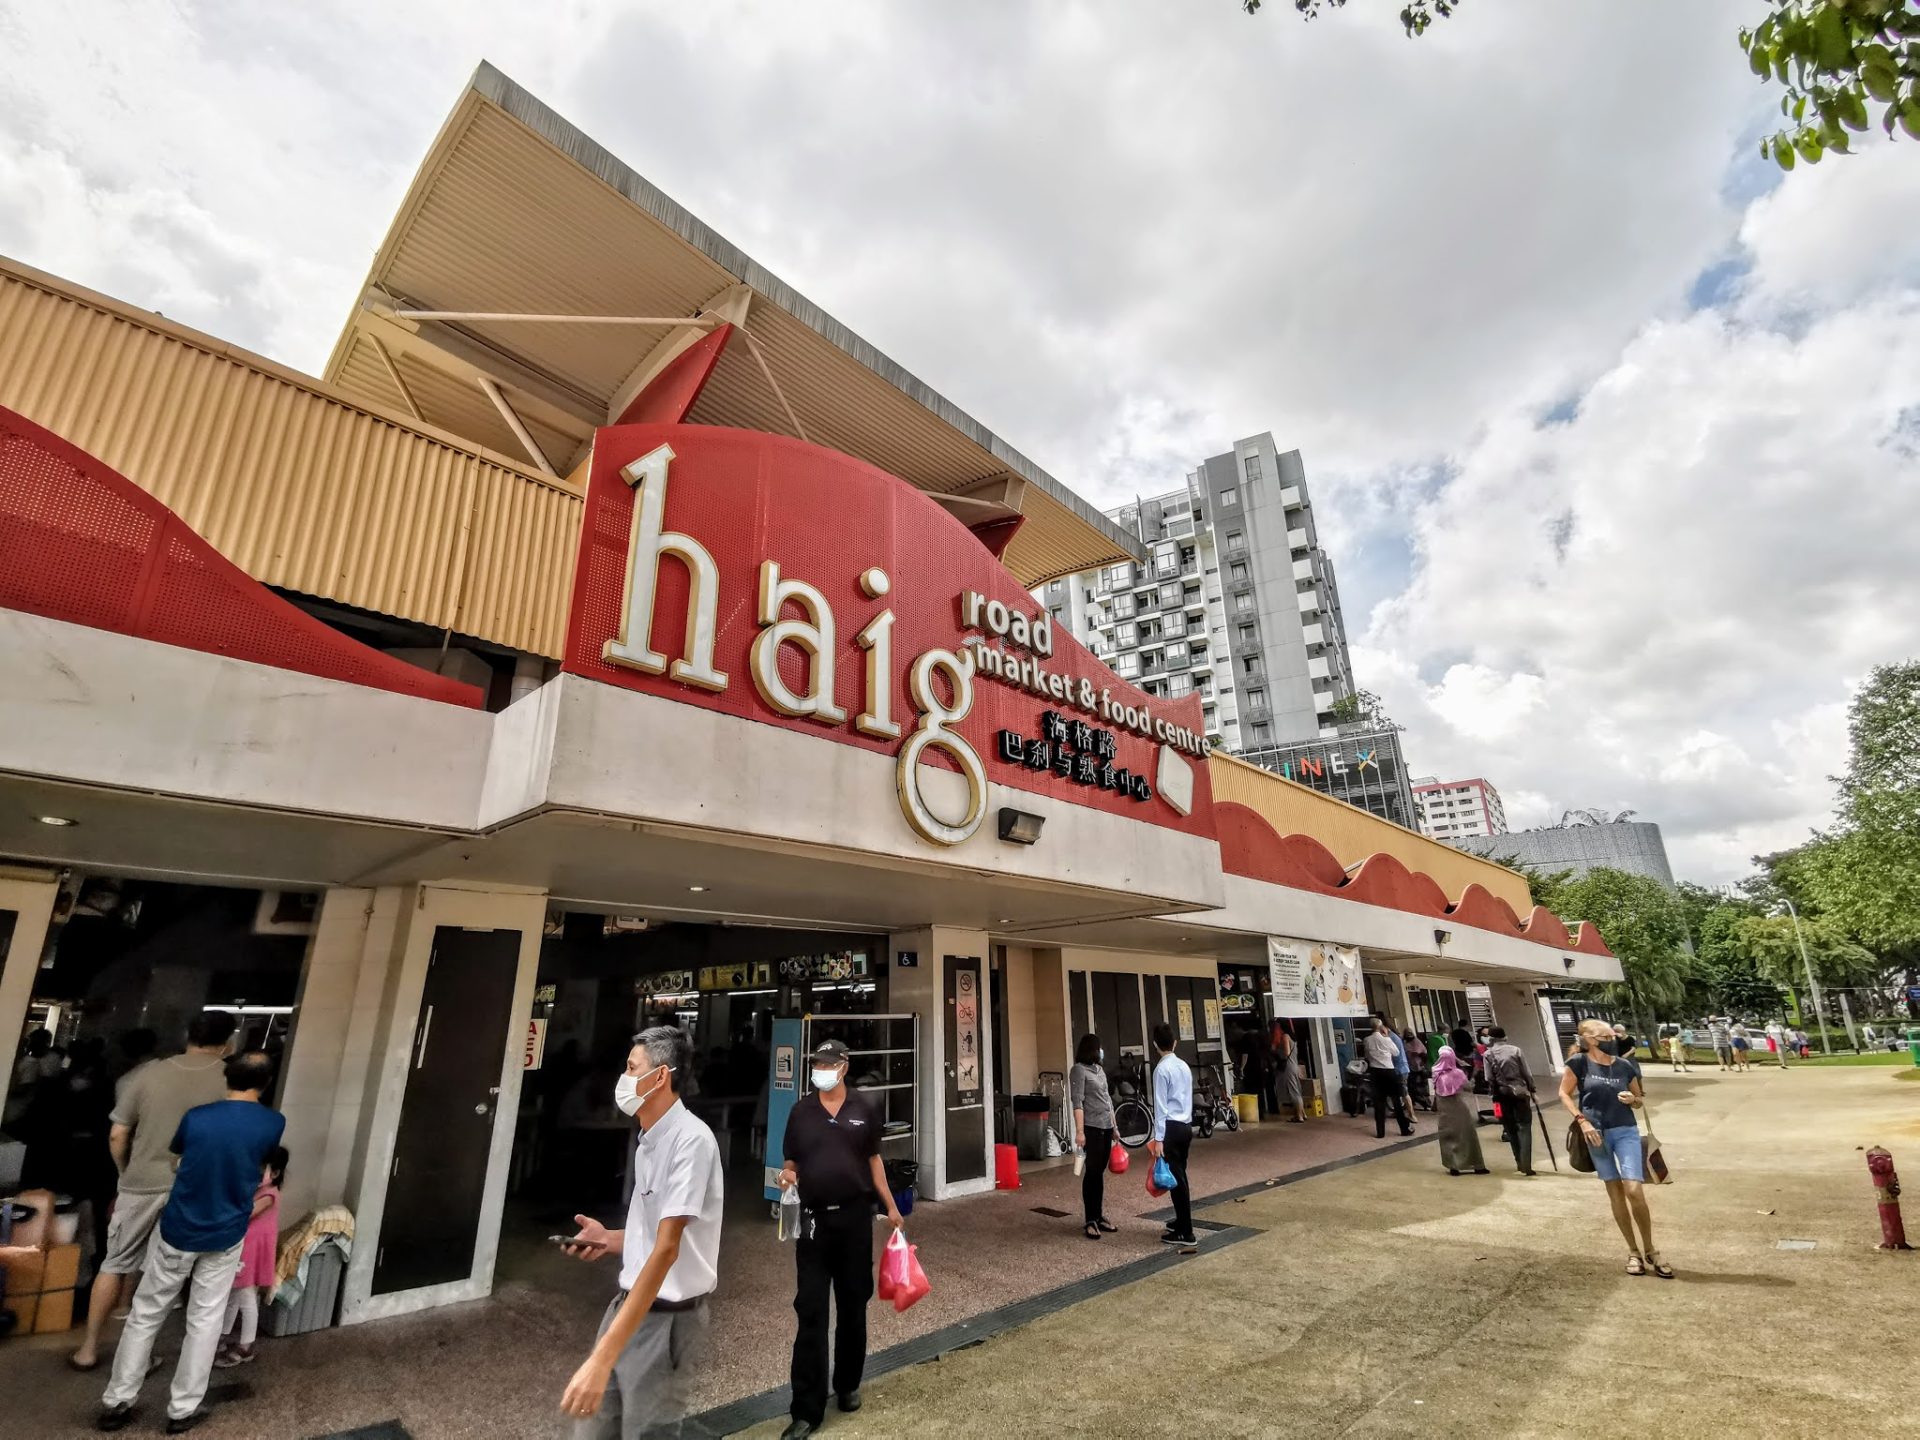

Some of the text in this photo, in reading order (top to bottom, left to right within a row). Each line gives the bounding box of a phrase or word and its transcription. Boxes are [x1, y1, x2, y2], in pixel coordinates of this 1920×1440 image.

[602, 442, 988, 846] haig
[963, 590, 1053, 658] road
[975, 642, 1212, 758] market & food centre
[1002, 730, 1151, 800] 巴刹与熟食中心
[1046, 711, 1117, 760] 海格路
